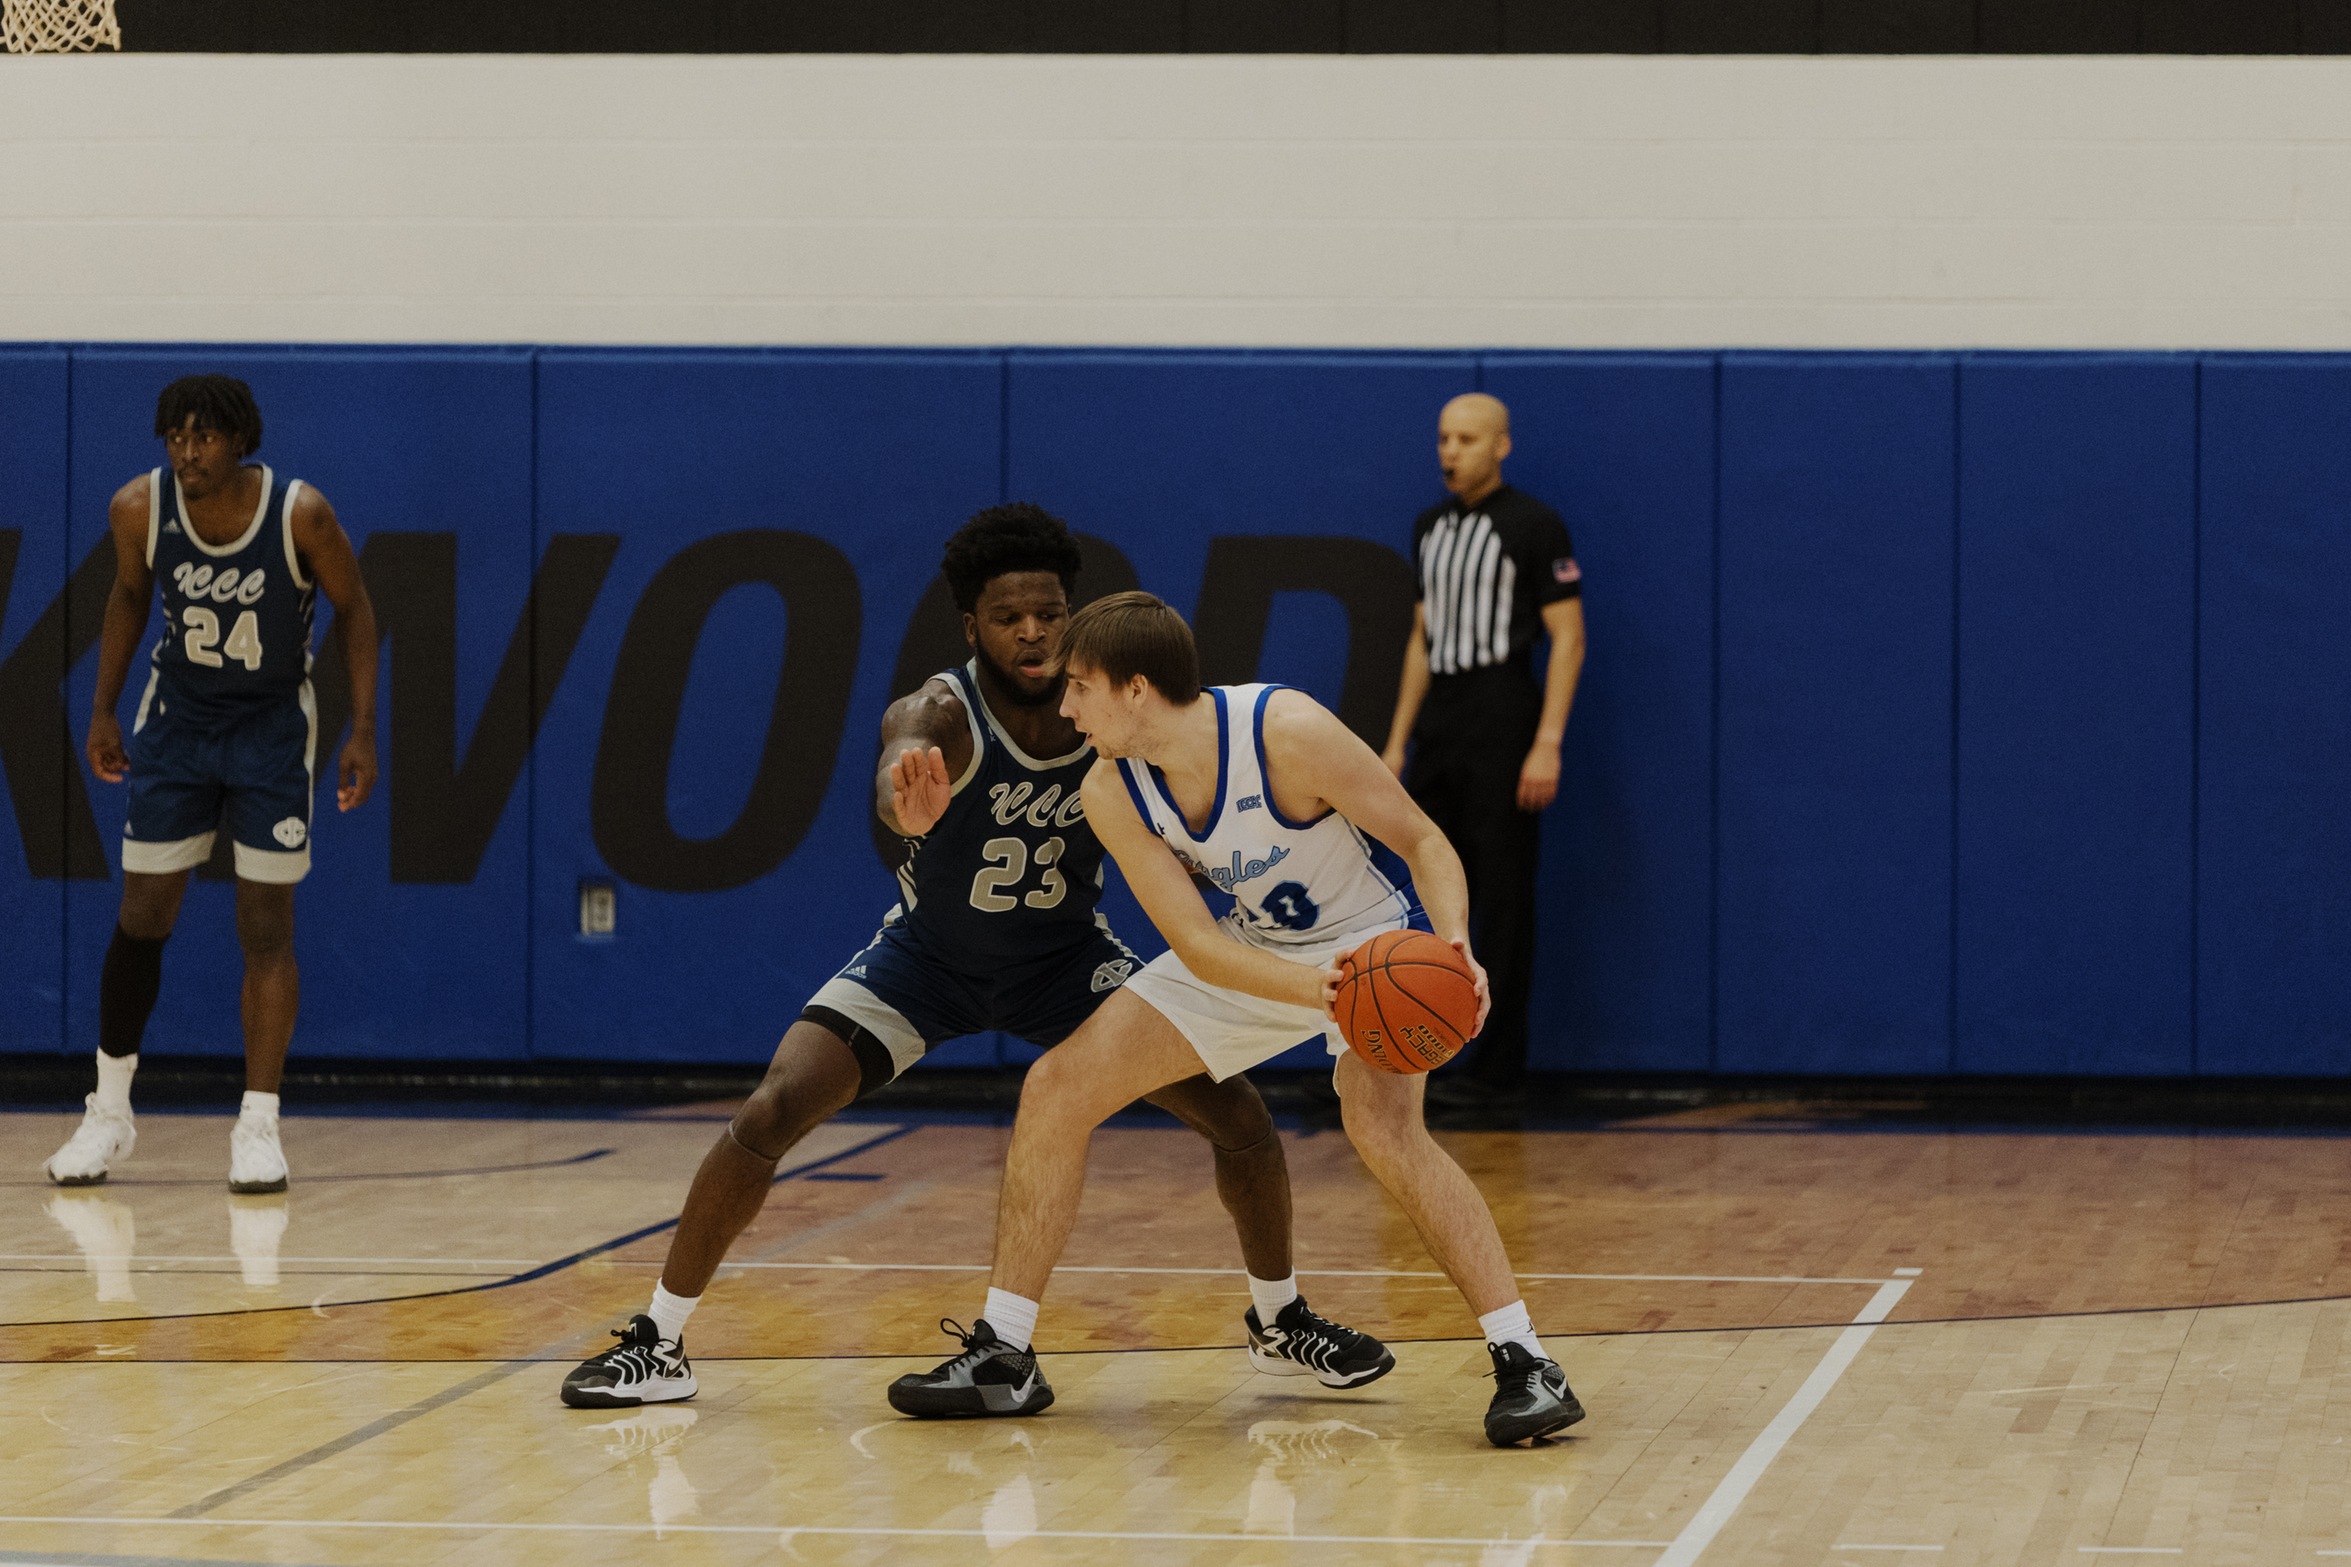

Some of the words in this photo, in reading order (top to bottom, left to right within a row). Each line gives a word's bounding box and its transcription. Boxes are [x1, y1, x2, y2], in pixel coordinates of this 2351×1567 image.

[182, 605, 263, 671] 24
[969, 836, 1067, 912] 23
[1399, 1026, 1443, 1065] EGACY
